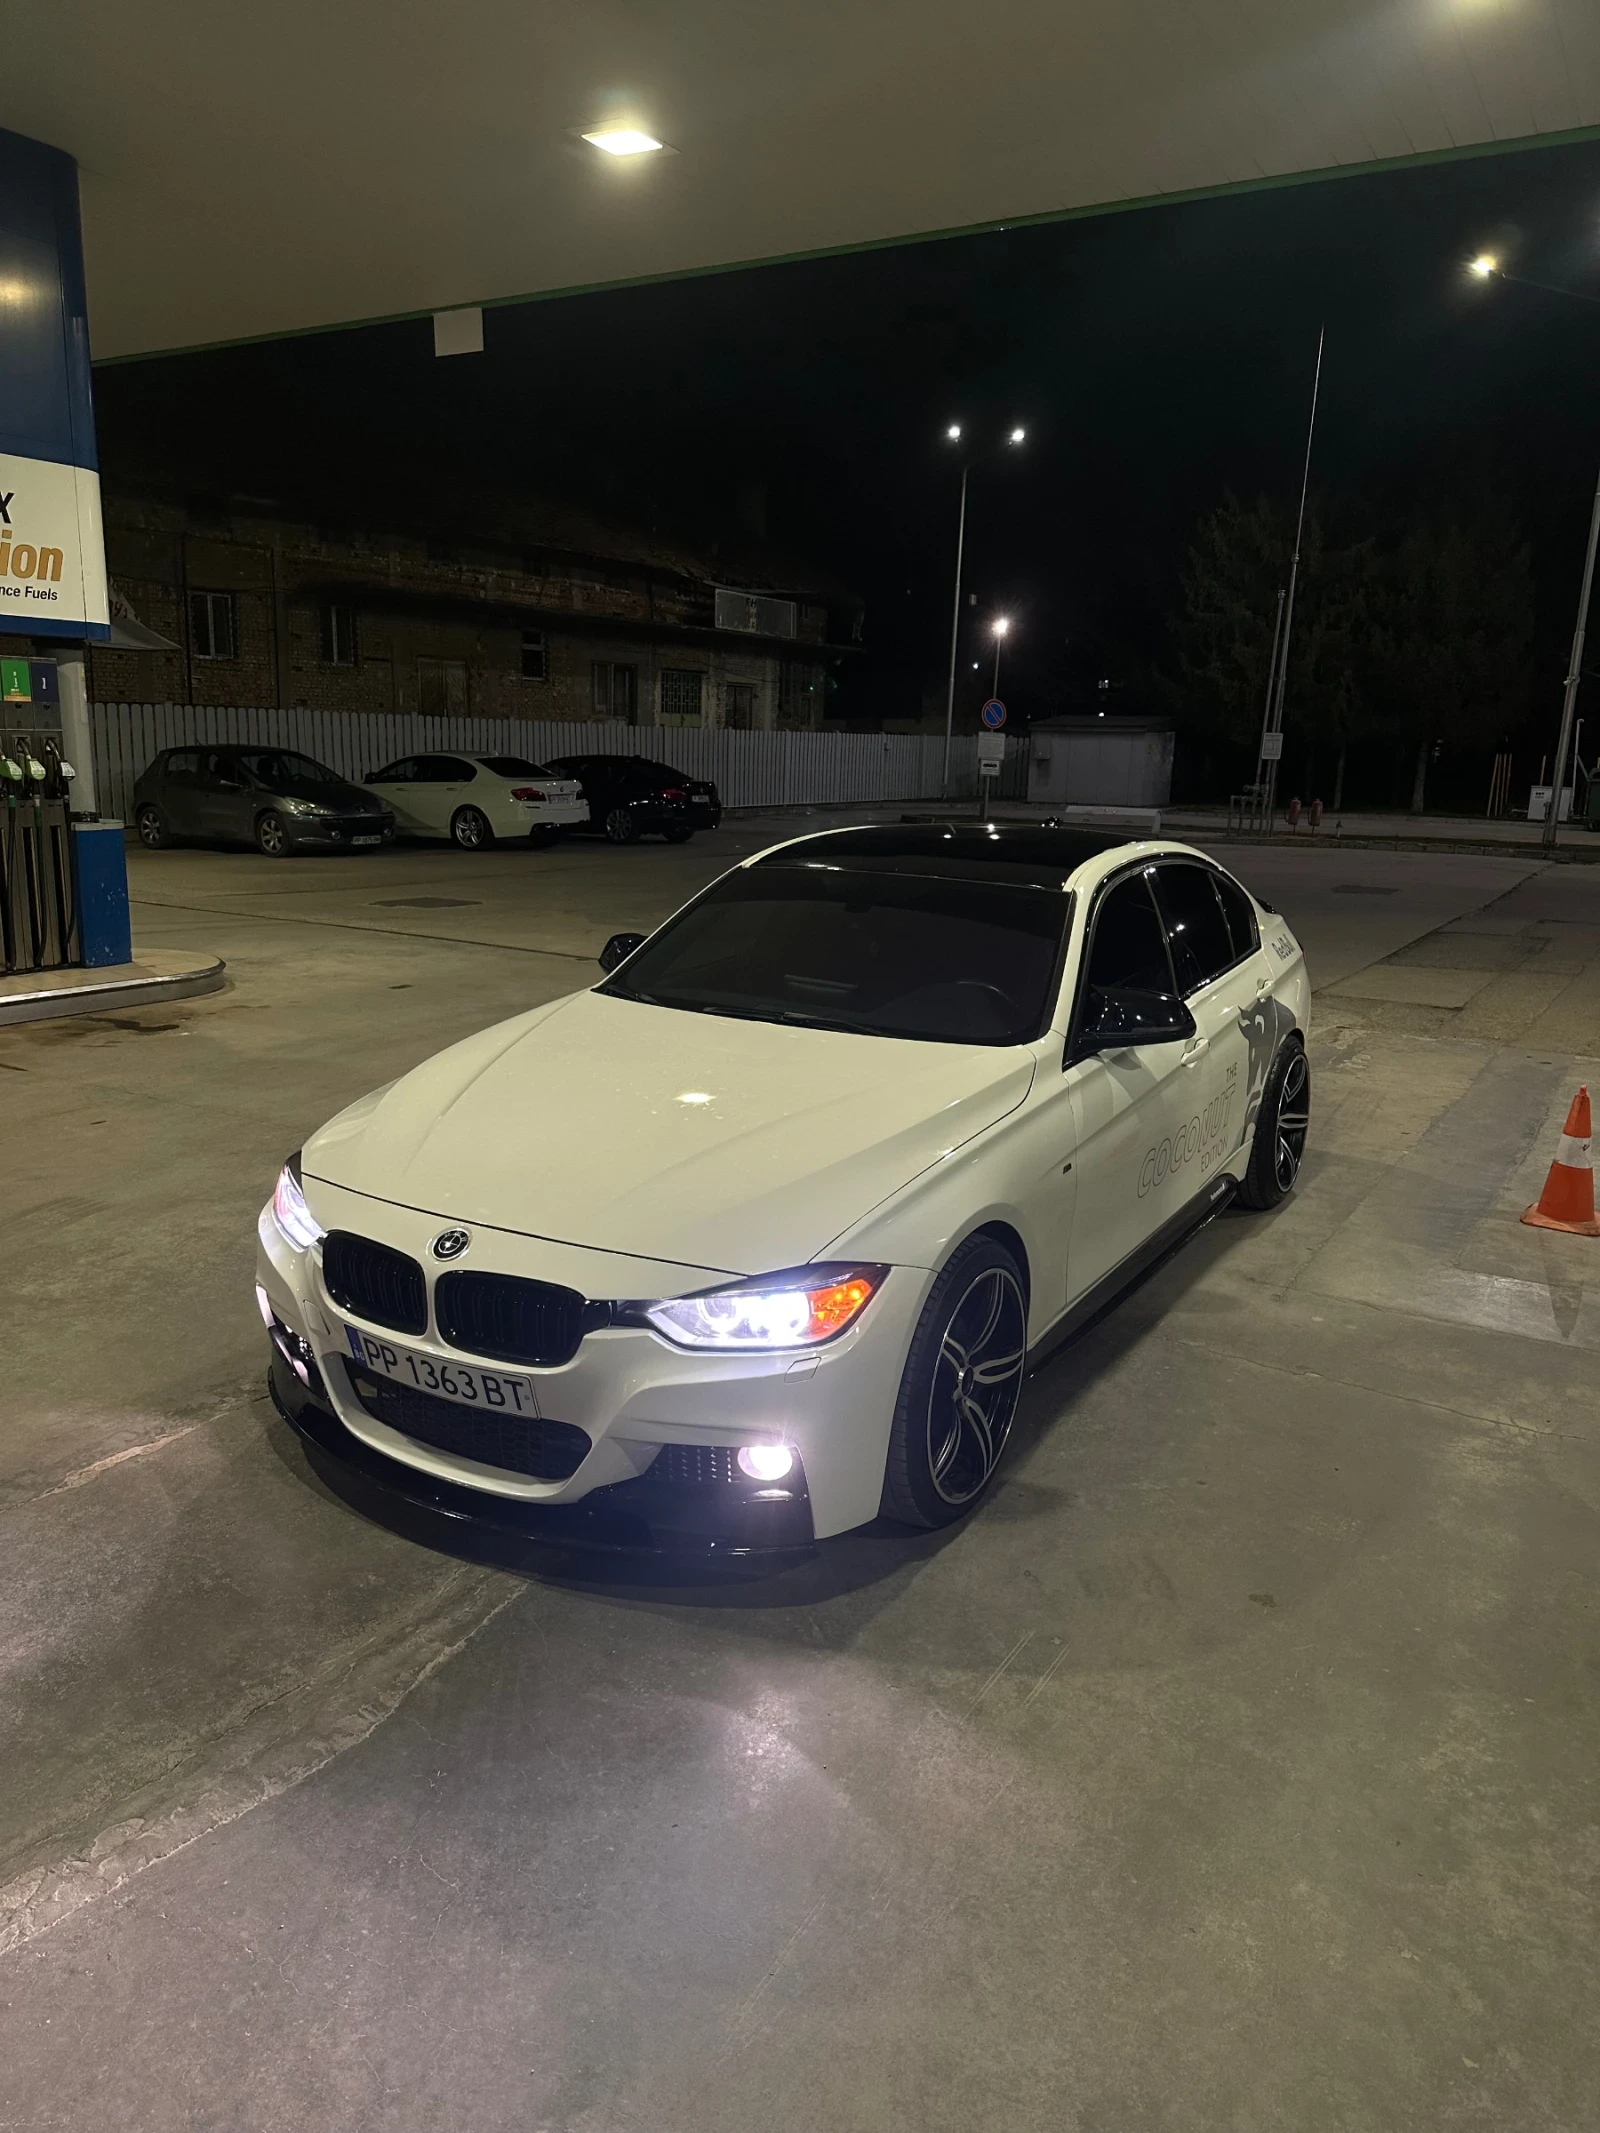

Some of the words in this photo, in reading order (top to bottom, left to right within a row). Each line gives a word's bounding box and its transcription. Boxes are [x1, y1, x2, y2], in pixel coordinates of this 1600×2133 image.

[0, 529, 63, 582] ion
[25, 585, 58, 601] Fuels
[1226, 1062, 1238, 1081] THE
[1138, 1083, 1236, 1198] COCONUT
[1201, 1134, 1229, 1172] EDITION
[363, 1338, 398, 1374] PP
[405, 1355, 478, 1400] 1363
[481, 1374, 524, 1411] BT
